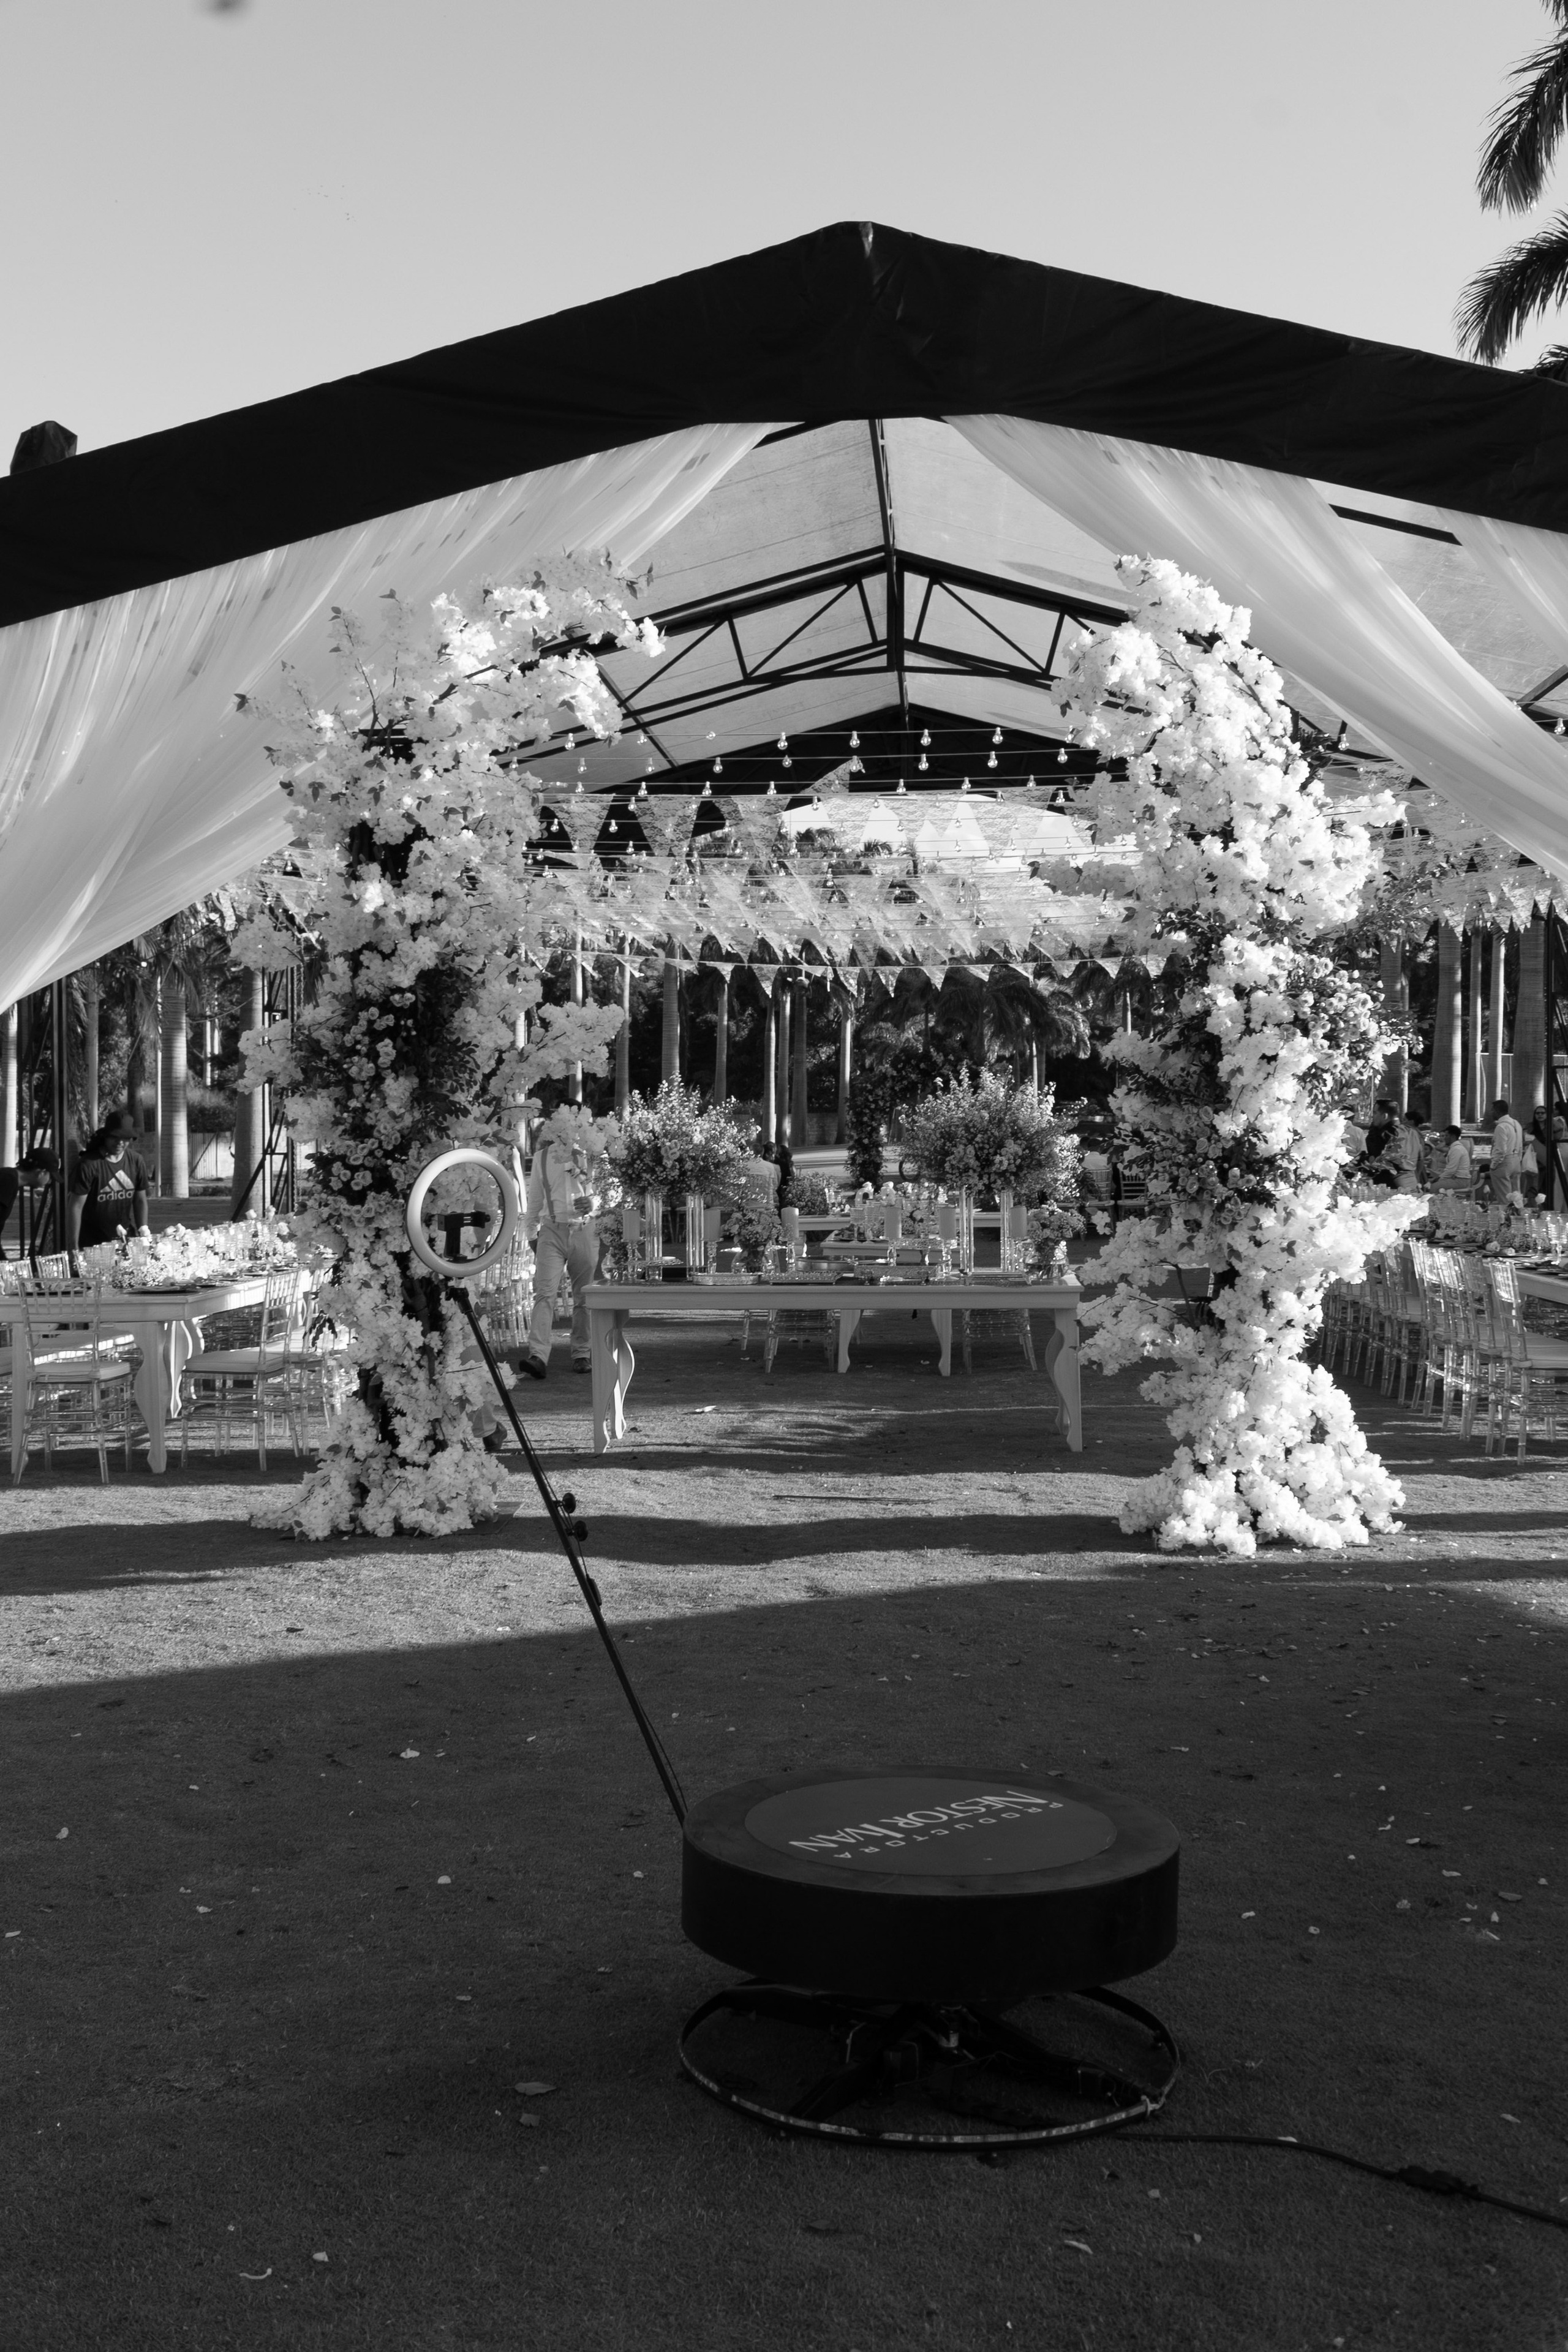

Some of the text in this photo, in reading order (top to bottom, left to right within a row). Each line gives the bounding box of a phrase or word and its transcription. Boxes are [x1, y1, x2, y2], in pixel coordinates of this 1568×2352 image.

[97, 1189, 135, 1202] adida
[788, 1790, 1049, 1852] NESTOR IVAN
[834, 1802, 1063, 1858] PRODUCTORA
